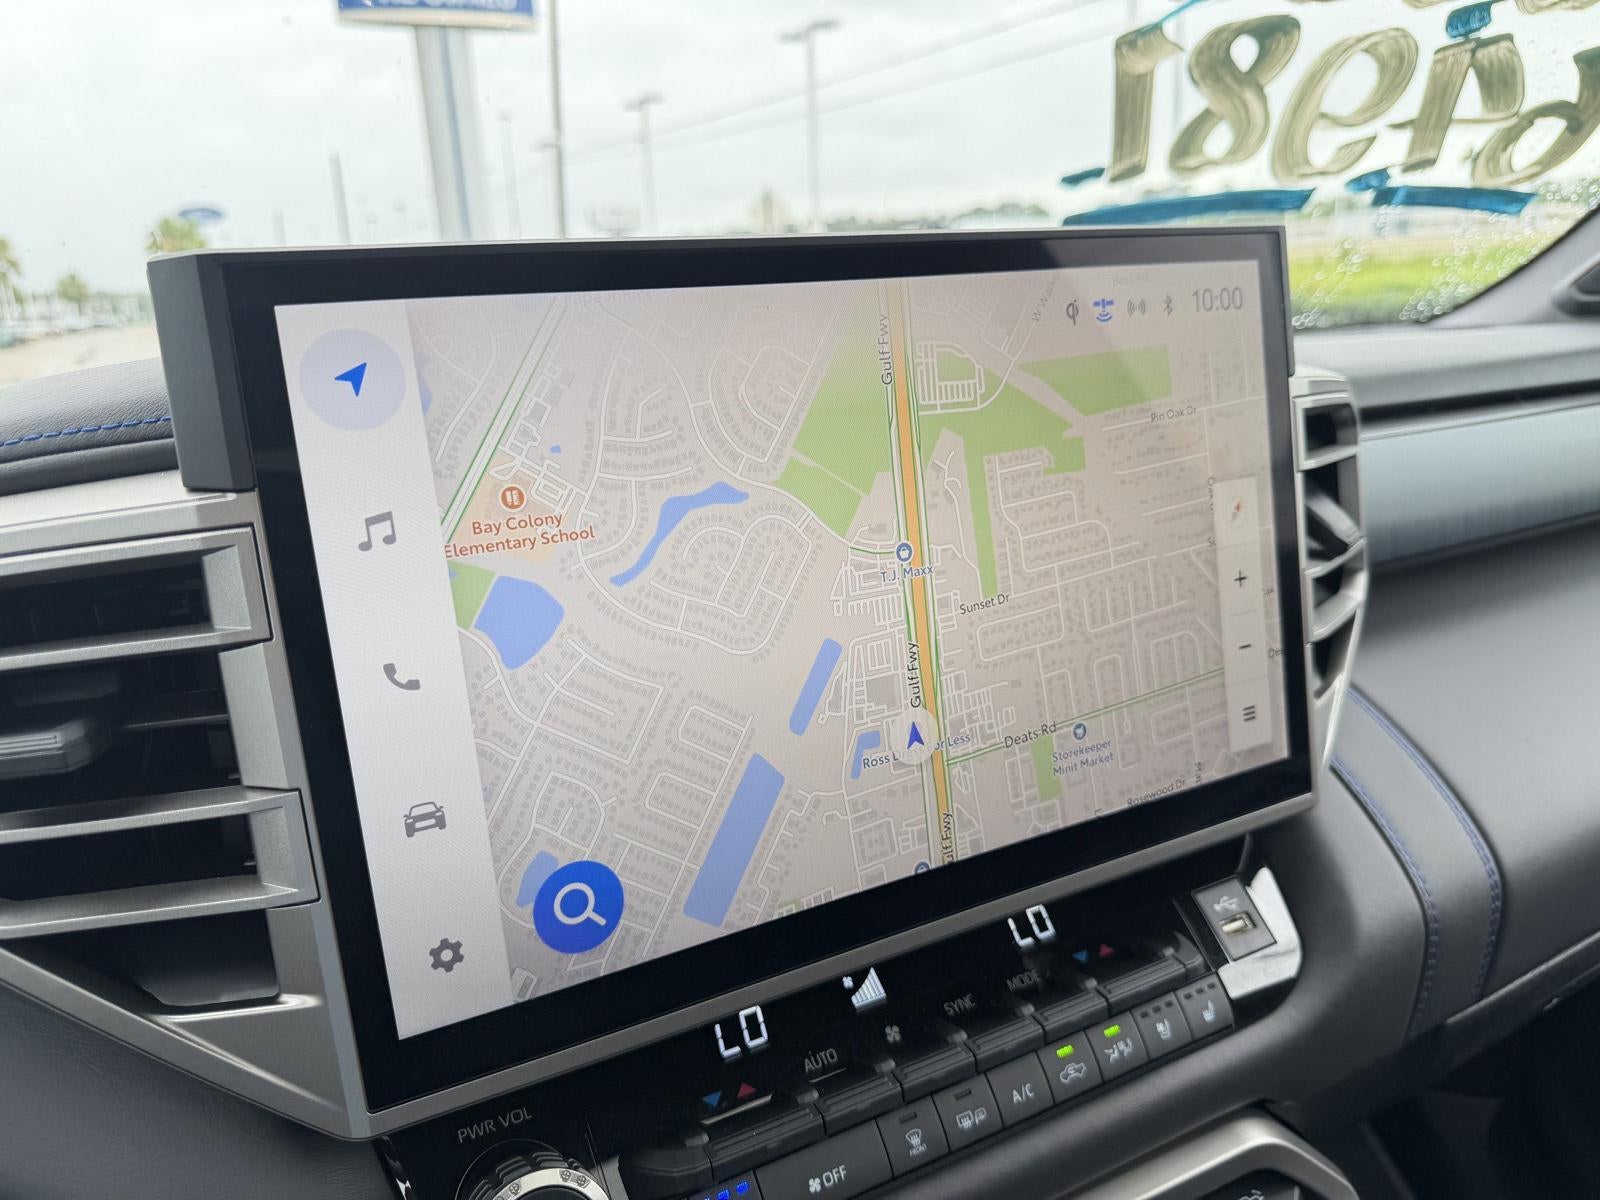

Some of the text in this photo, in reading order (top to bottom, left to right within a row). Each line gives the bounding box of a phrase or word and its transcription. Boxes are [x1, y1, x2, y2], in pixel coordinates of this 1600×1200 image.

[1192, 286, 1243, 312] 10:00
[877, 314, 893, 386] Gulf Fwy
[1151, 405, 1197, 424] Pin Oak Dr
[472, 513, 563, 537] Bay Colony
[444, 525, 596, 560] Elementary School
[880, 565, 934, 583] T.J. Maxx
[960, 593, 1011, 615] Sunset Dr
[907, 642, 922, 708] Gulf Fwy
[1004, 721, 1057, 749] Deats Rd
[863, 755, 890, 769] Ross
[949, 734, 971, 747] Less
[1052, 739, 1112, 763] Storekeeper
[1053, 752, 1114, 777] Minit Market
[1127, 783, 1174, 807] Rosewood
[942, 812, 955, 863] ulf Fwy
[1007, 903, 1057, 948] LO
[1006, 969, 1040, 992] MODE
[943, 993, 976, 1016] SYNC
[714, 1004, 769, 1060] LO
[804, 1049, 838, 1073] AUTO
[1012, 1083, 1034, 1105] A/C
[457, 1106, 532, 1143] PWR VOL
[822, 1164, 847, 1187] OFF
